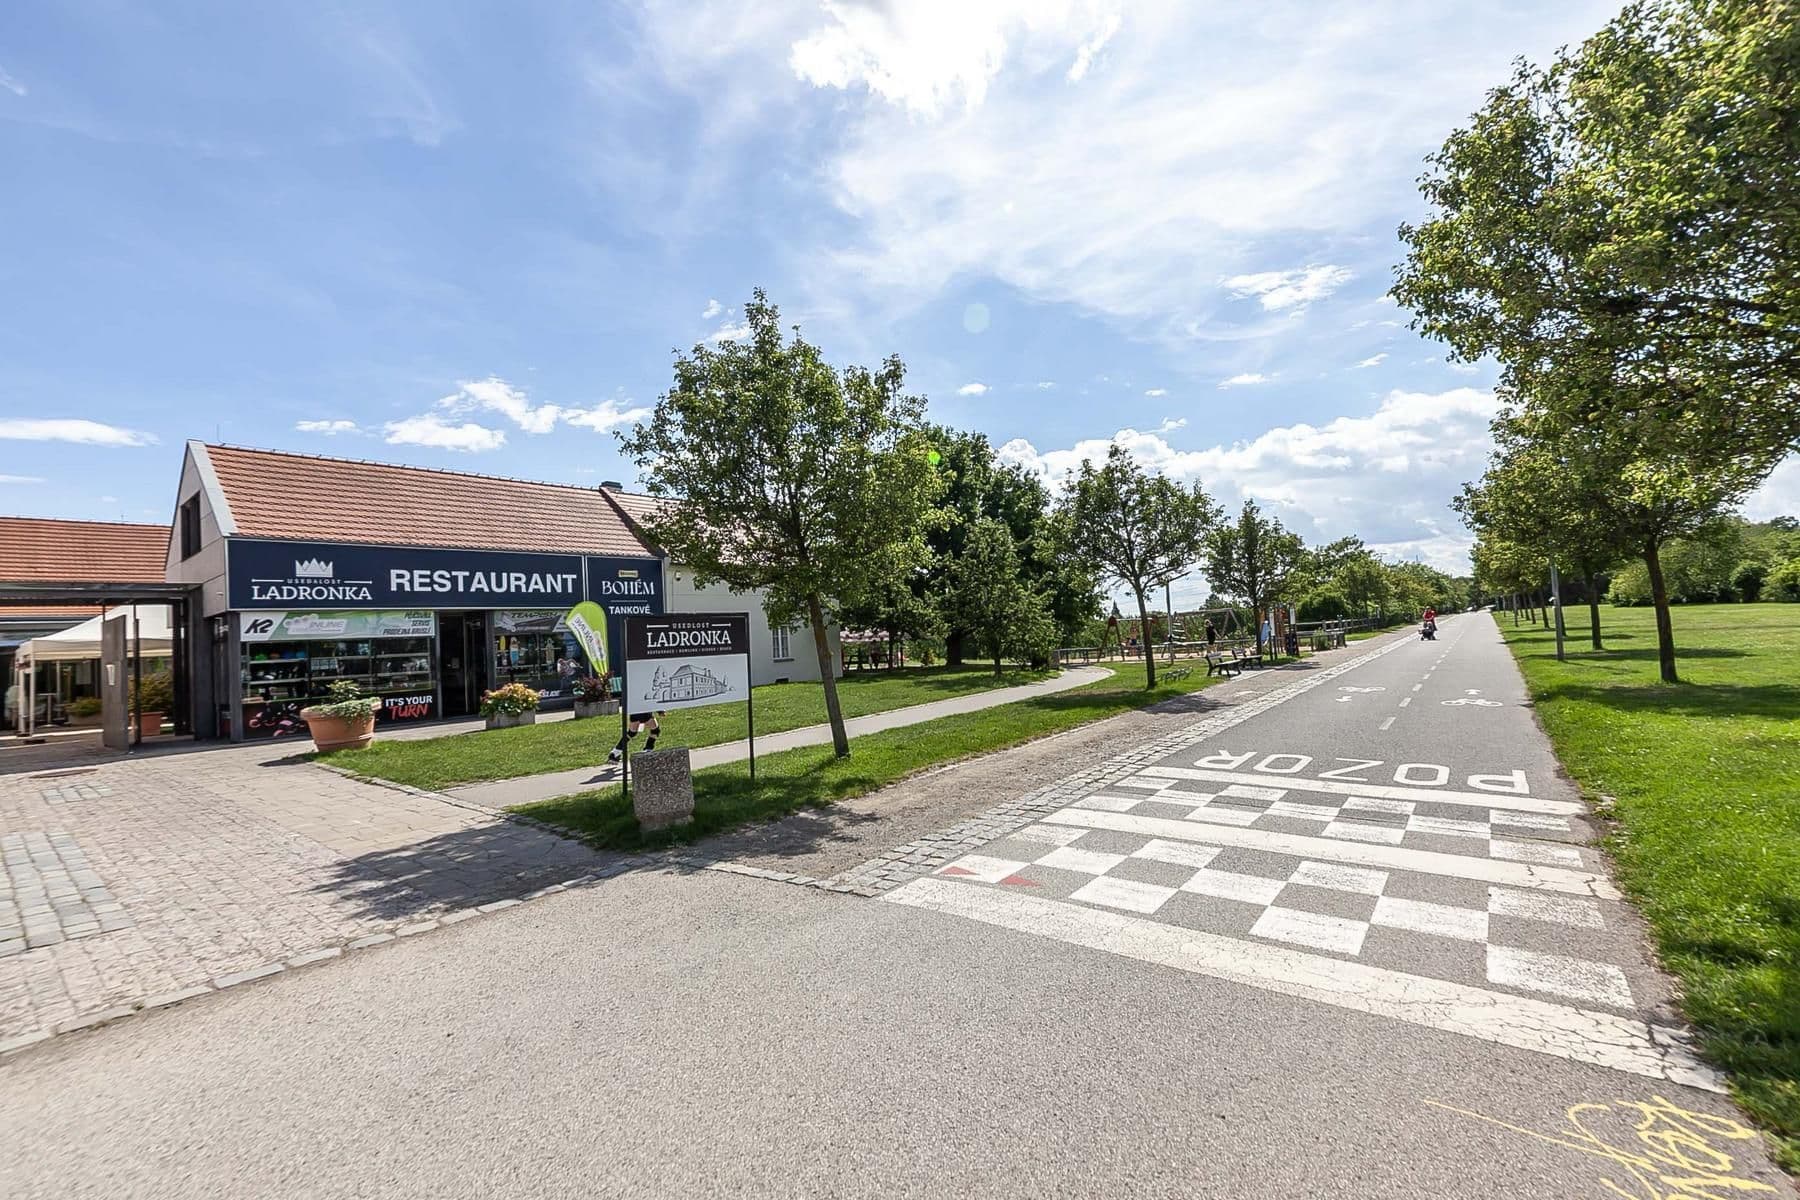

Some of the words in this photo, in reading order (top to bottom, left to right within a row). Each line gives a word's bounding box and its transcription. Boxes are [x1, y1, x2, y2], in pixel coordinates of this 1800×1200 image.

[390, 569, 577, 593] RESTAURANT
[601, 579, 655, 595] BOHÉM
[251, 585, 373, 600] LADRONKA
[608, 603, 651, 615] TANKOVÉ
[244, 619, 274, 634] K2
[646, 629, 732, 648] LADRONKA
[385, 698, 405, 707] IT'S
[405, 695, 433, 705] YOUR
[389, 703, 428, 720] TURN
[1193, 749, 1531, 795] POZOR
